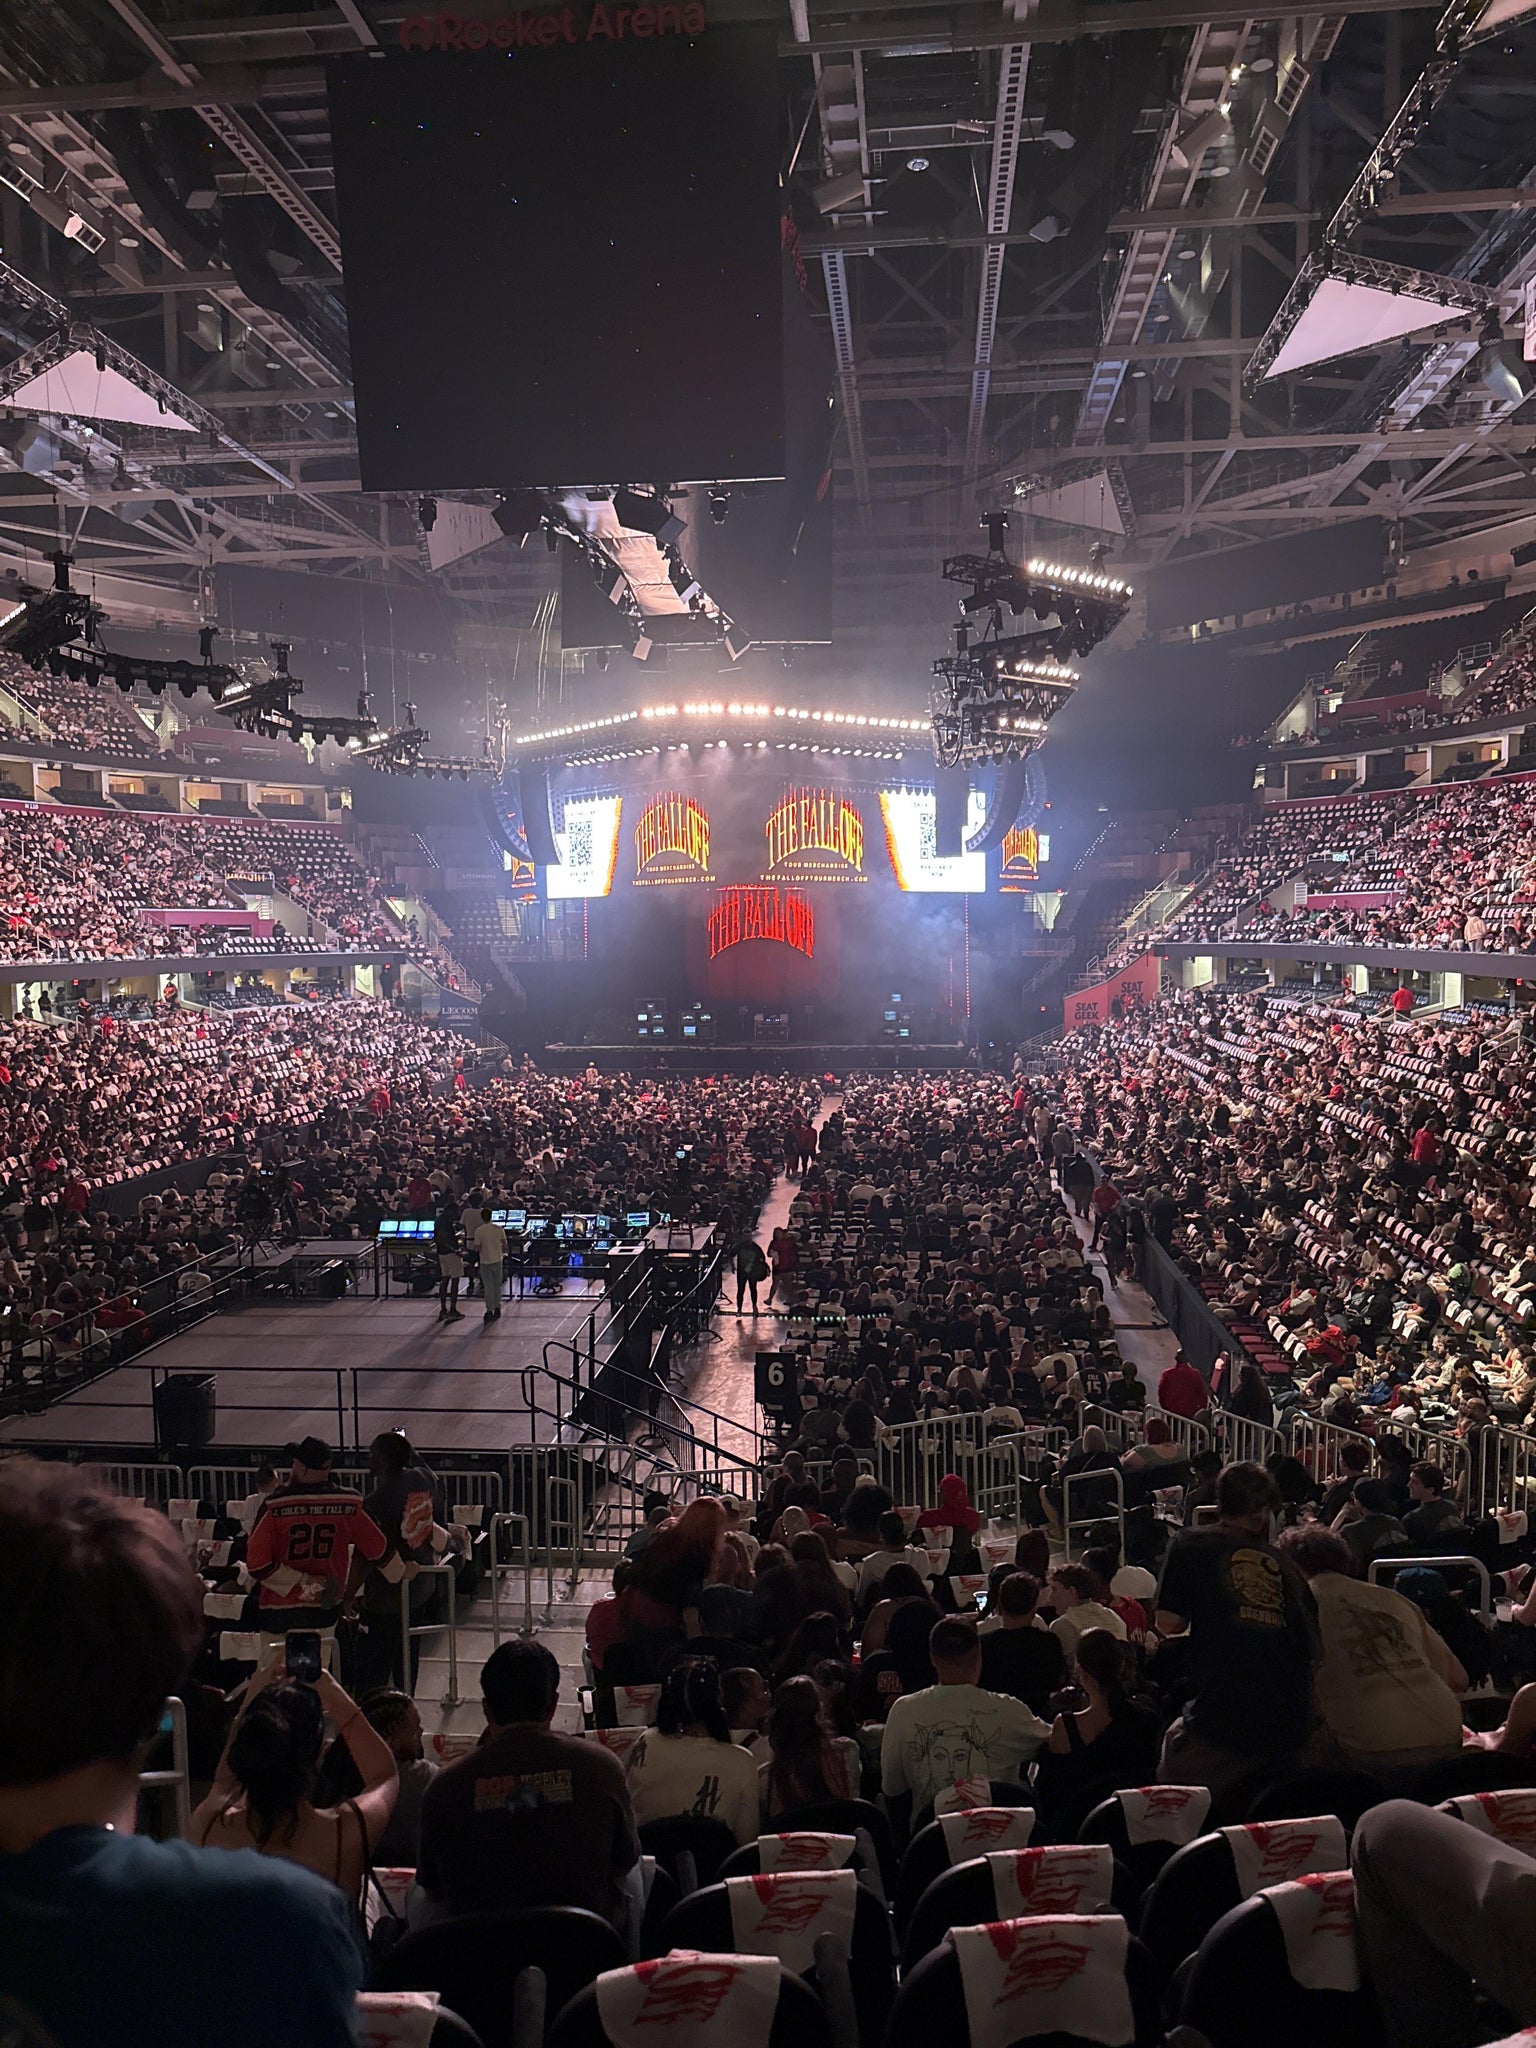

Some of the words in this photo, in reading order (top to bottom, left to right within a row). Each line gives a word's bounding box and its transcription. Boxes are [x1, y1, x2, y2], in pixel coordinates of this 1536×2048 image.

[438, 8, 577, 51] Rocket
[586, 1, 706, 42] Arena
[765, 800, 799, 871] THE
[783, 861, 802, 869] TOUR
[803, 861, 849, 870] MERCHANDISE
[708, 898, 741, 959] THE
[1121, 981, 1144, 993] SEAT
[442, 1006, 479, 1015] LECOM
[1075, 1002, 1098, 1012] SEAT
[1074, 1011, 1099, 1020] GEEK
[559, 1129, 567, 1140] 2
[183, 1280, 197, 1290] 42
[768, 1361, 785, 1386] 6
[1086, 1380, 1102, 1394] 15
[281, 1506, 299, 1516] COLE
[309, 1505, 324, 1515] THE
[325, 1504, 343, 1514] FALL
[287, 1521, 336, 1560] 26
